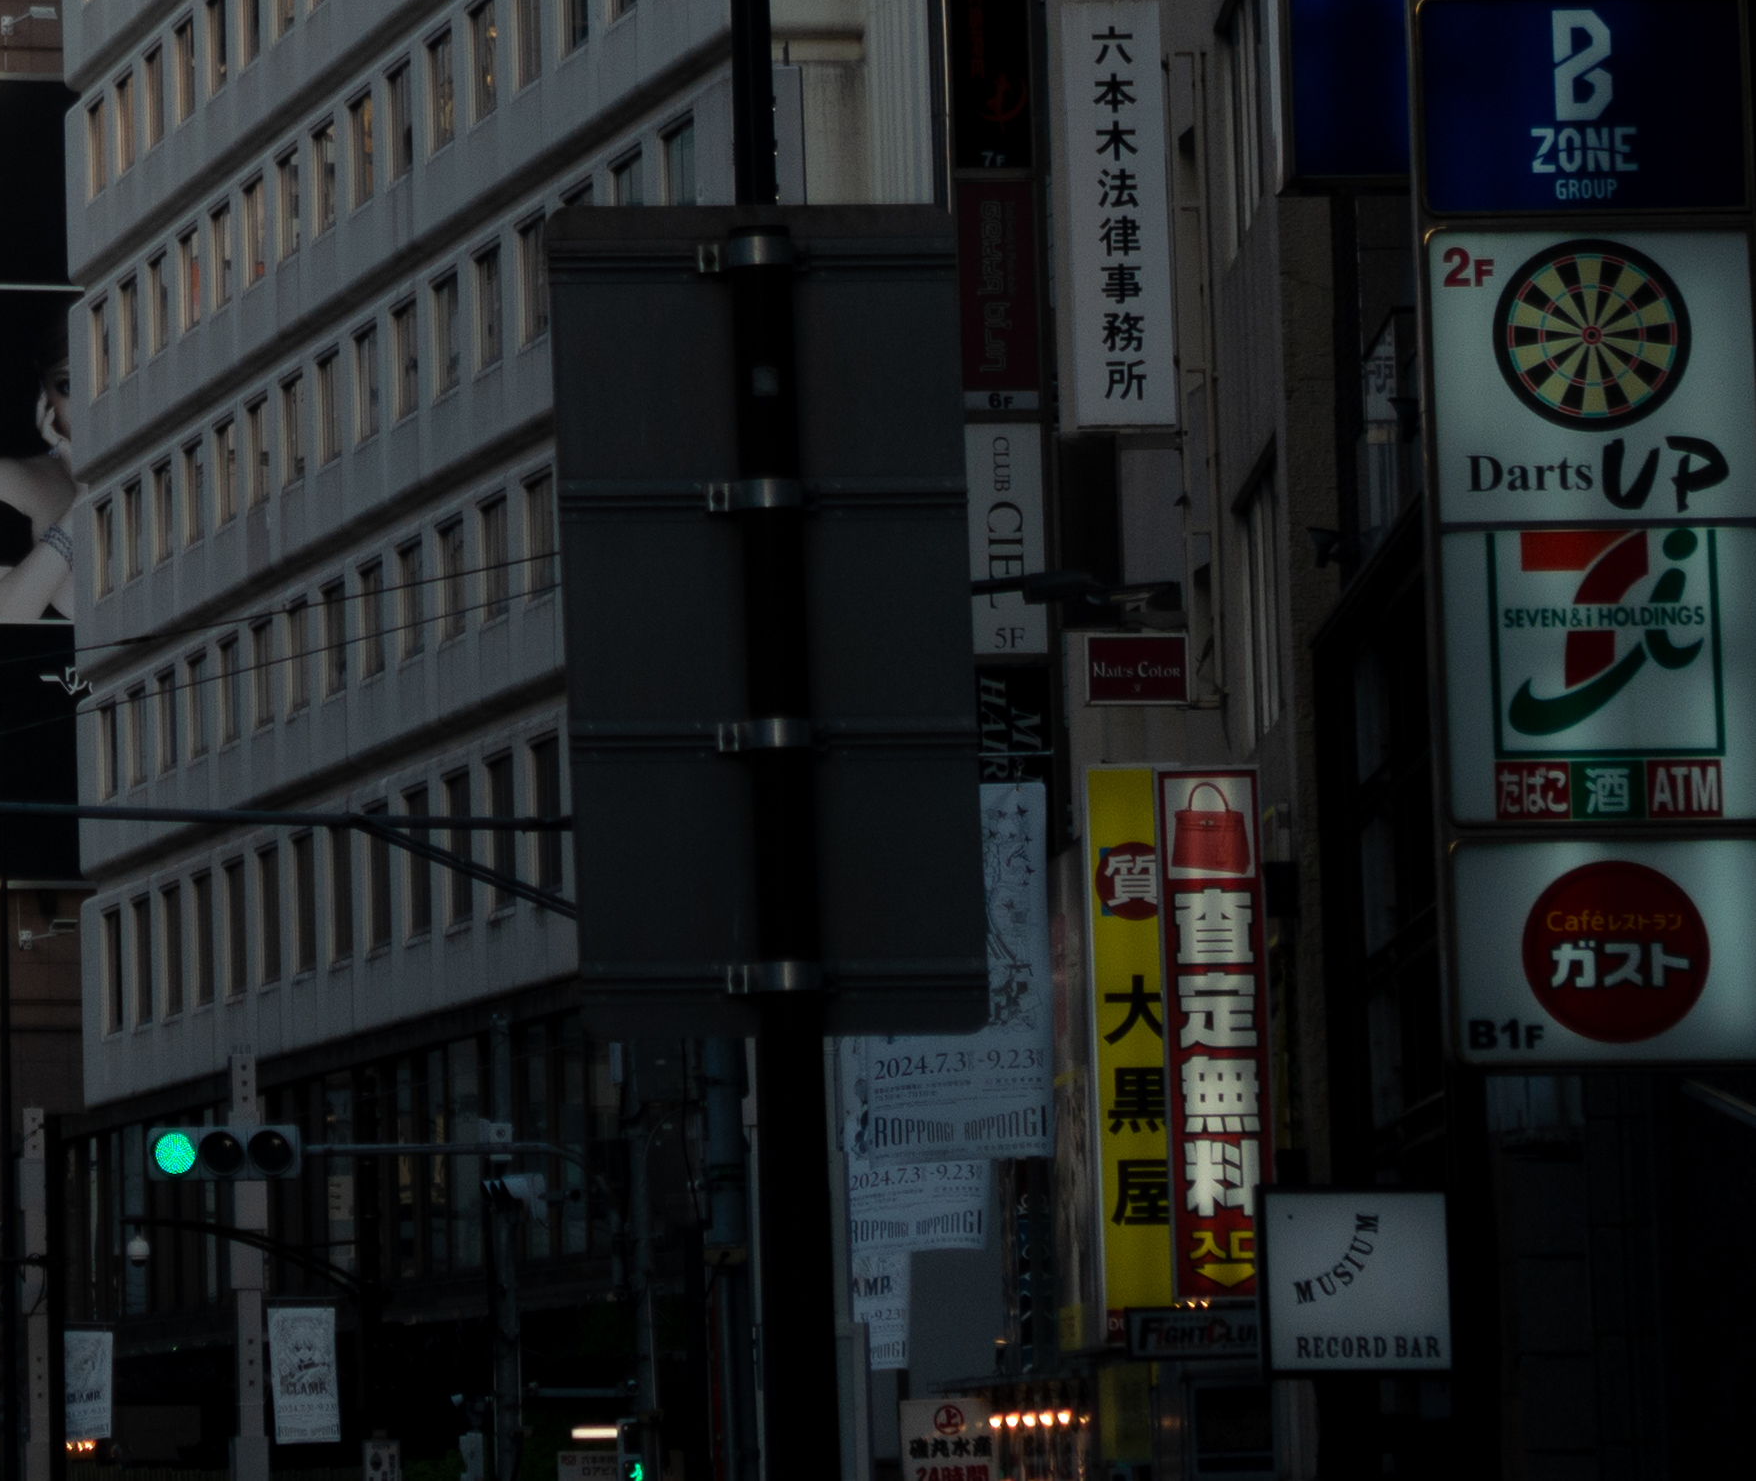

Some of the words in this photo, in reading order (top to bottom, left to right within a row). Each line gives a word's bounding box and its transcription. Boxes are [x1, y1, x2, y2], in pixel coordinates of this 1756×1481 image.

[980, 151, 1007, 167] 7F
[1531, 126, 1640, 174] ZONE
[1554, 179, 1620, 200] GROUP
[1088, 25, 1150, 402] 六本木法律事務所
[1442, 247, 1495, 288] 2F
[988, 393, 1013, 409] 6F
[992, 436, 1011, 492] CLUB
[1466, 454, 1594, 492] Darts
[1602, 435, 1730, 513] UP
[993, 626, 1026, 649] 5F
[1597, 606, 1706, 627] HOLDINGS
[979, 675, 1011, 780] HAIR
[1498, 768, 1568, 814] たばこ
[1585, 767, 1630, 813] 酒
[1652, 766, 1720, 812] ATM
[1104, 854, 1160, 907] 質
[1548, 939, 1693, 990] ガスト
[1175, 888, 1263, 1218] 査定無料
[1468, 1019, 1545, 1051] B1F
[874, 1050, 967, 1080] 2024.7.3
[1103, 975, 1171, 1226] 大黒屋
[874, 1116, 955, 1149] ROPPONGI
[963, 1105, 1048, 1142] ROPPONGI
[850, 1165, 921, 1192] 2024.7.3
[915, 1209, 982, 1236] ROPPONGI
[1293, 1212, 1379, 1305] MUSIUM
[1296, 1336, 1388, 1359] RECORD
[1394, 1335, 1442, 1359] BAR
[909, 1435, 993, 1459] 磯丸水産
